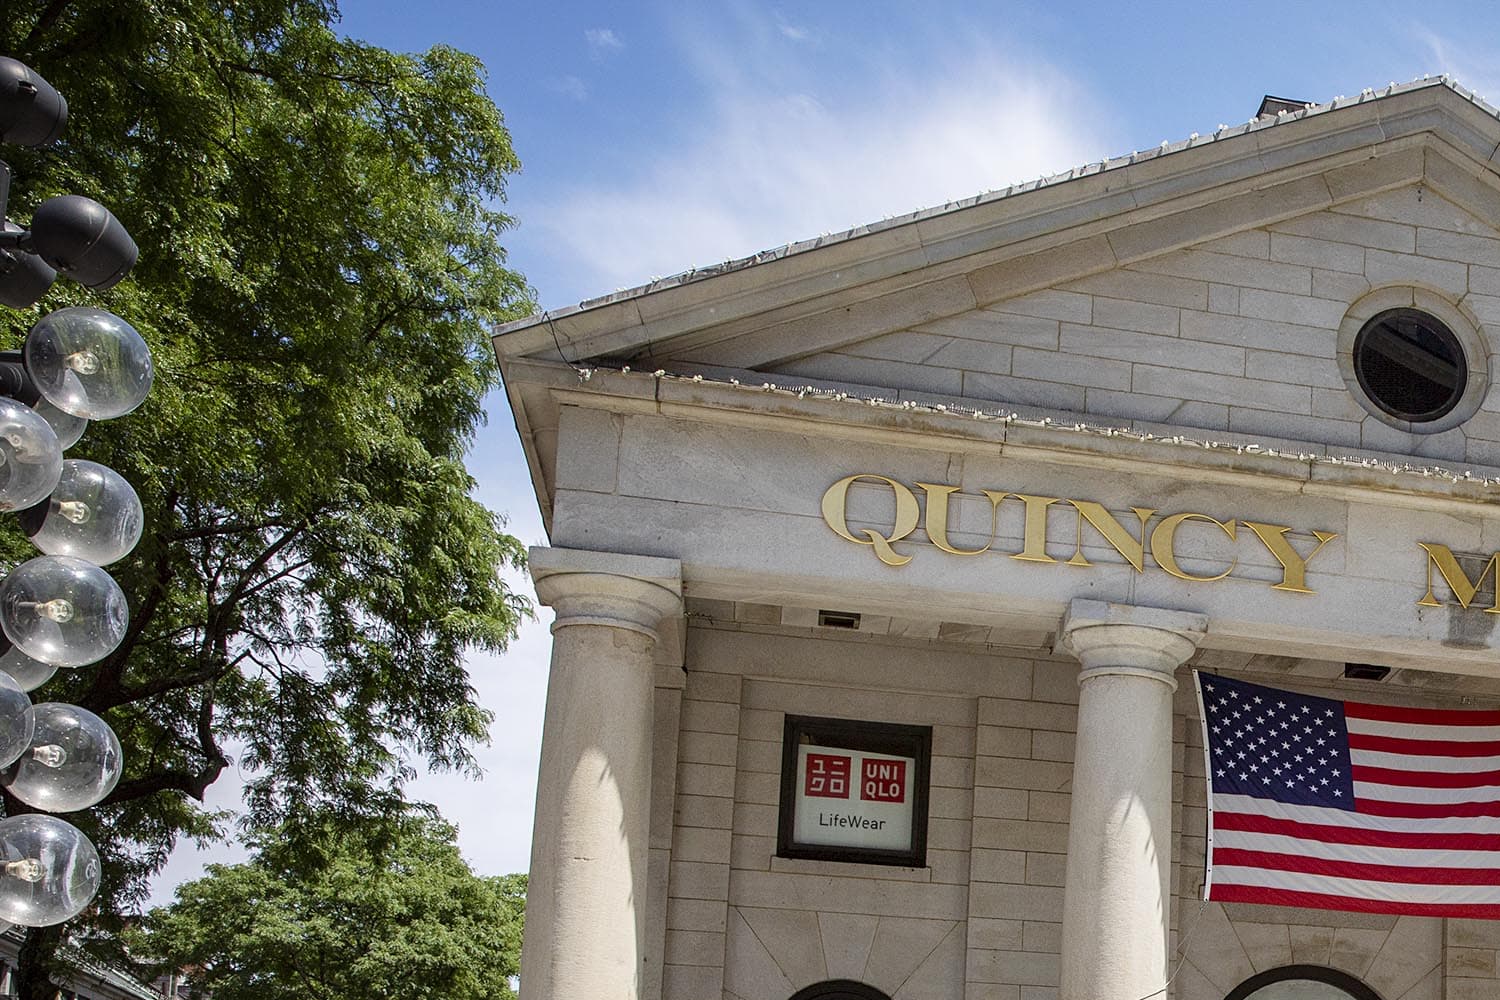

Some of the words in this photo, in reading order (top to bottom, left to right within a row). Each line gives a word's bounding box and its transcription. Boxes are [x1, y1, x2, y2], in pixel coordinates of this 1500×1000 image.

[821, 474, 1339, 593] QUINCY
[866, 764, 898, 780] UNI
[866, 782, 900, 799] QLO
[819, 812, 886, 830] LifeWear
